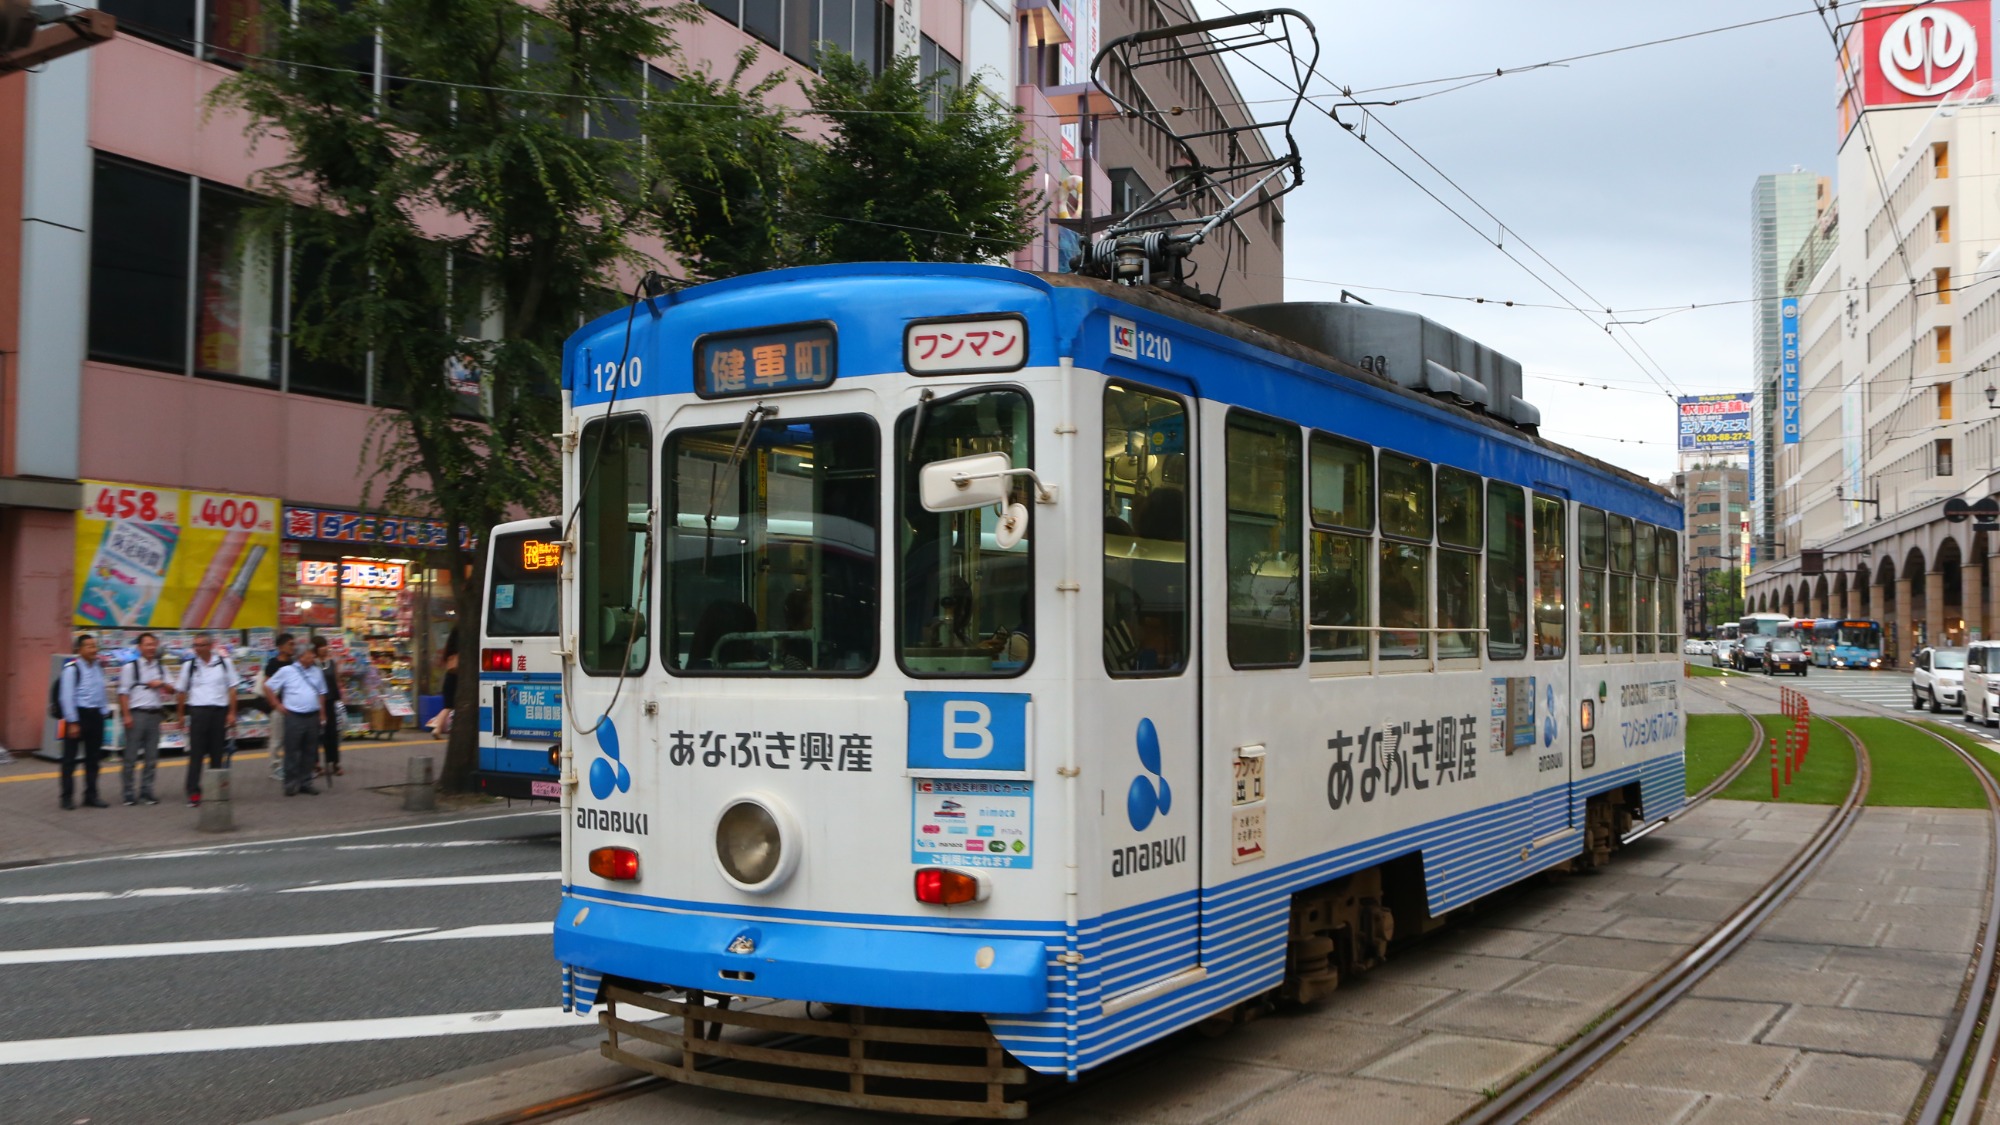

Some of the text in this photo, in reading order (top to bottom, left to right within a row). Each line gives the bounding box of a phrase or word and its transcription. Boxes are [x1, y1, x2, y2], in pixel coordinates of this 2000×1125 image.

[915, 331, 1016, 359] ワンマン
[1138, 330, 1172, 363] 1210
[594, 357, 642, 393] 1210
[711, 339, 831, 393] 健軍町
[1784, 332, 1798, 435] Tsuruya
[96, 488, 159, 521] 458
[202, 498, 258, 529] 400
[289, 509, 316, 537] 薬
[517, 655, 527, 671] 産
[519, 691, 545, 706] ほんだ
[943, 700, 994, 759] B
[669, 730, 873, 772] あなぶき興産
[1327, 714, 1477, 810] あなぶき興産
[1237, 778, 1261, 801] 出口
[979, 807, 1016, 818] nimoca
[932, 854, 1013, 867] ご利用になれます
